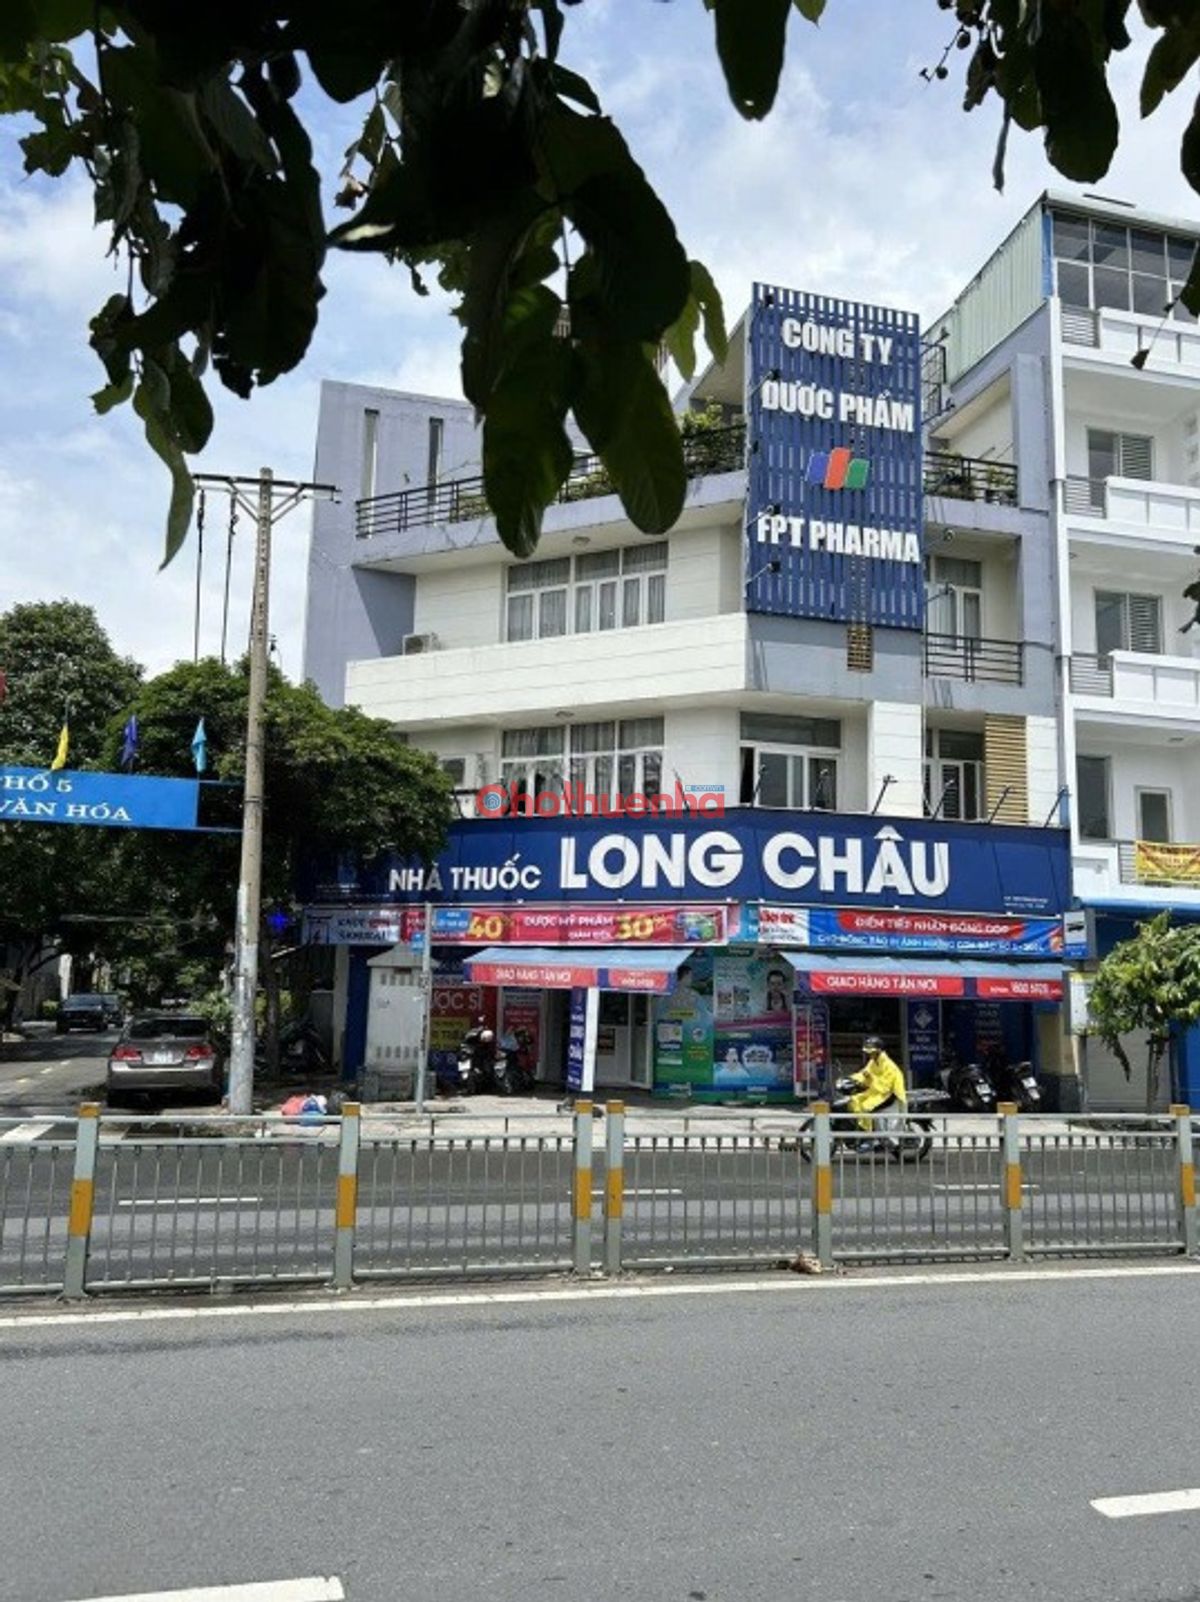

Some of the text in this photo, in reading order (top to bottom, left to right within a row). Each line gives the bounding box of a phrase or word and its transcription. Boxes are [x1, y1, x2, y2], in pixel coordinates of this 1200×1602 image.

[782, 317, 893, 366] CÔNG TY
[761, 379, 915, 432] DƯỢC PHẨM
[757, 512, 921, 564] FPT PHARMA
[0, 772, 73, 793] HỐ 5
[65, 802, 132, 821] HÓA
[389, 825, 950, 897] NHÀ THUỐC LONG CHÂU
[859, 974, 891, 990] HÀNG
